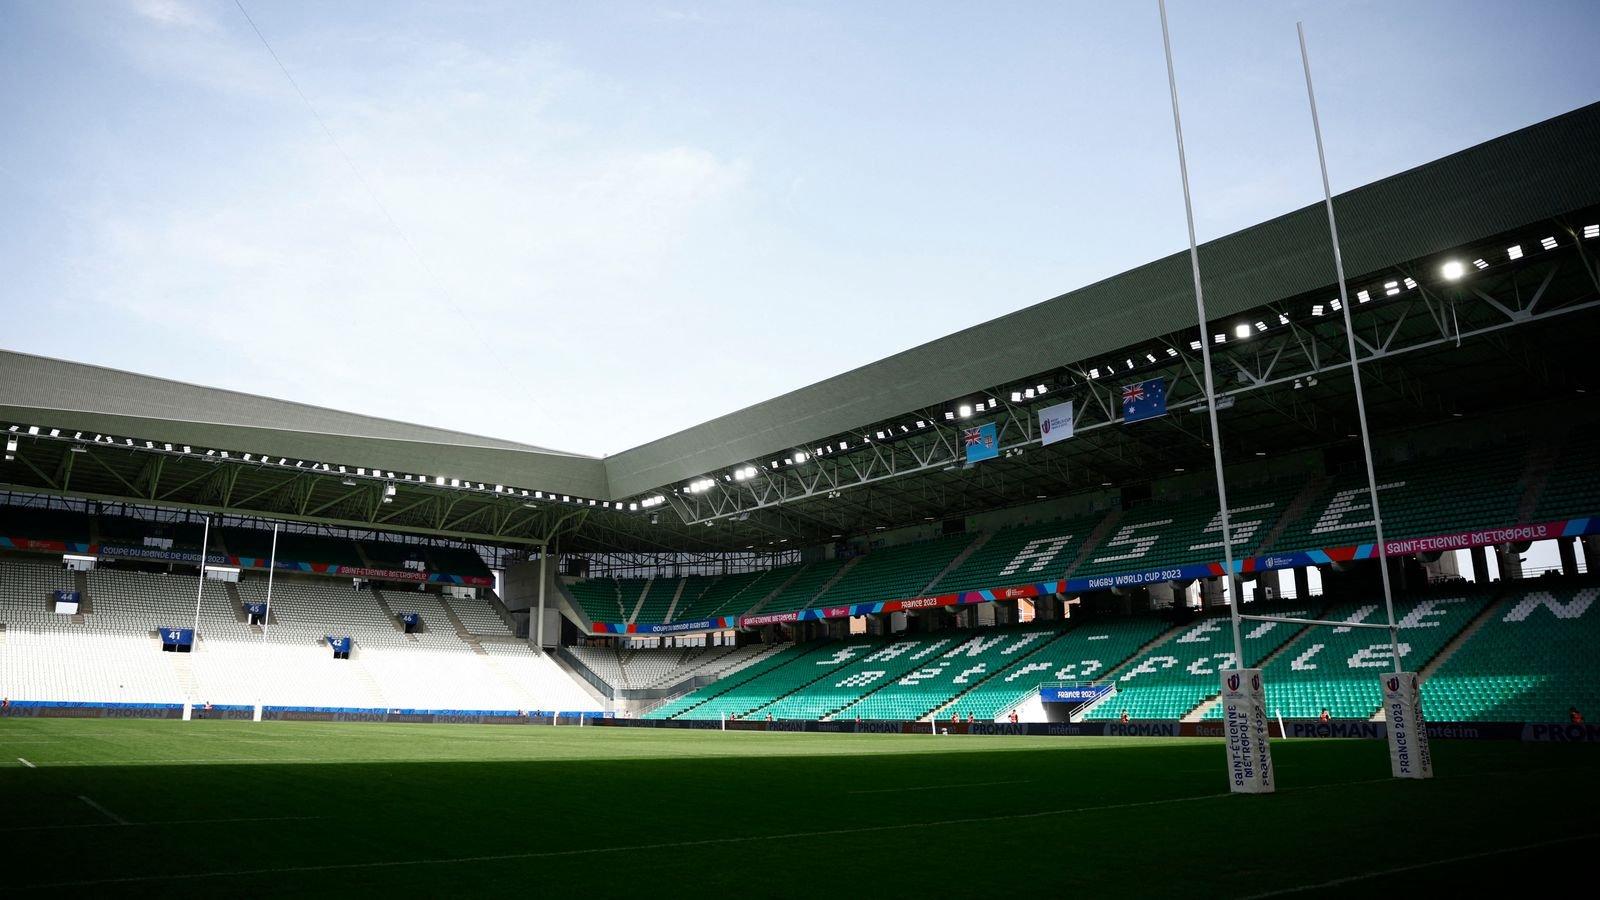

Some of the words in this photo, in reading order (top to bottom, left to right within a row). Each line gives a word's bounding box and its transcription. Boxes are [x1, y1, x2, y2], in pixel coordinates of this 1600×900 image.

[999, 481, 1406, 576] ASSE
[183, 552, 205, 562] RUGB
[1088, 576, 1113, 588] RUGBY
[1115, 574, 1142, 585] WORLD
[1144, 572, 1160, 582] CUP
[1162, 569, 1182, 580] 2023
[60, 593, 73, 601] 44
[923, 597, 937, 606] 2023
[250, 605, 259, 613] 45
[168, 631, 181, 640] 41
[332, 639, 342, 647] 42
[107, 708, 162, 718] PROMAN
[228, 711, 278, 719] PROAN
[1392, 703, 1405, 728] 2023
[858, 723, 899, 733] PROMAN
[973, 723, 1023, 735] PROMAN
[1110, 723, 1174, 736] PROMAN
[1294, 723, 1378, 739] PROMAN
[1426, 726, 1479, 739] ntérim
